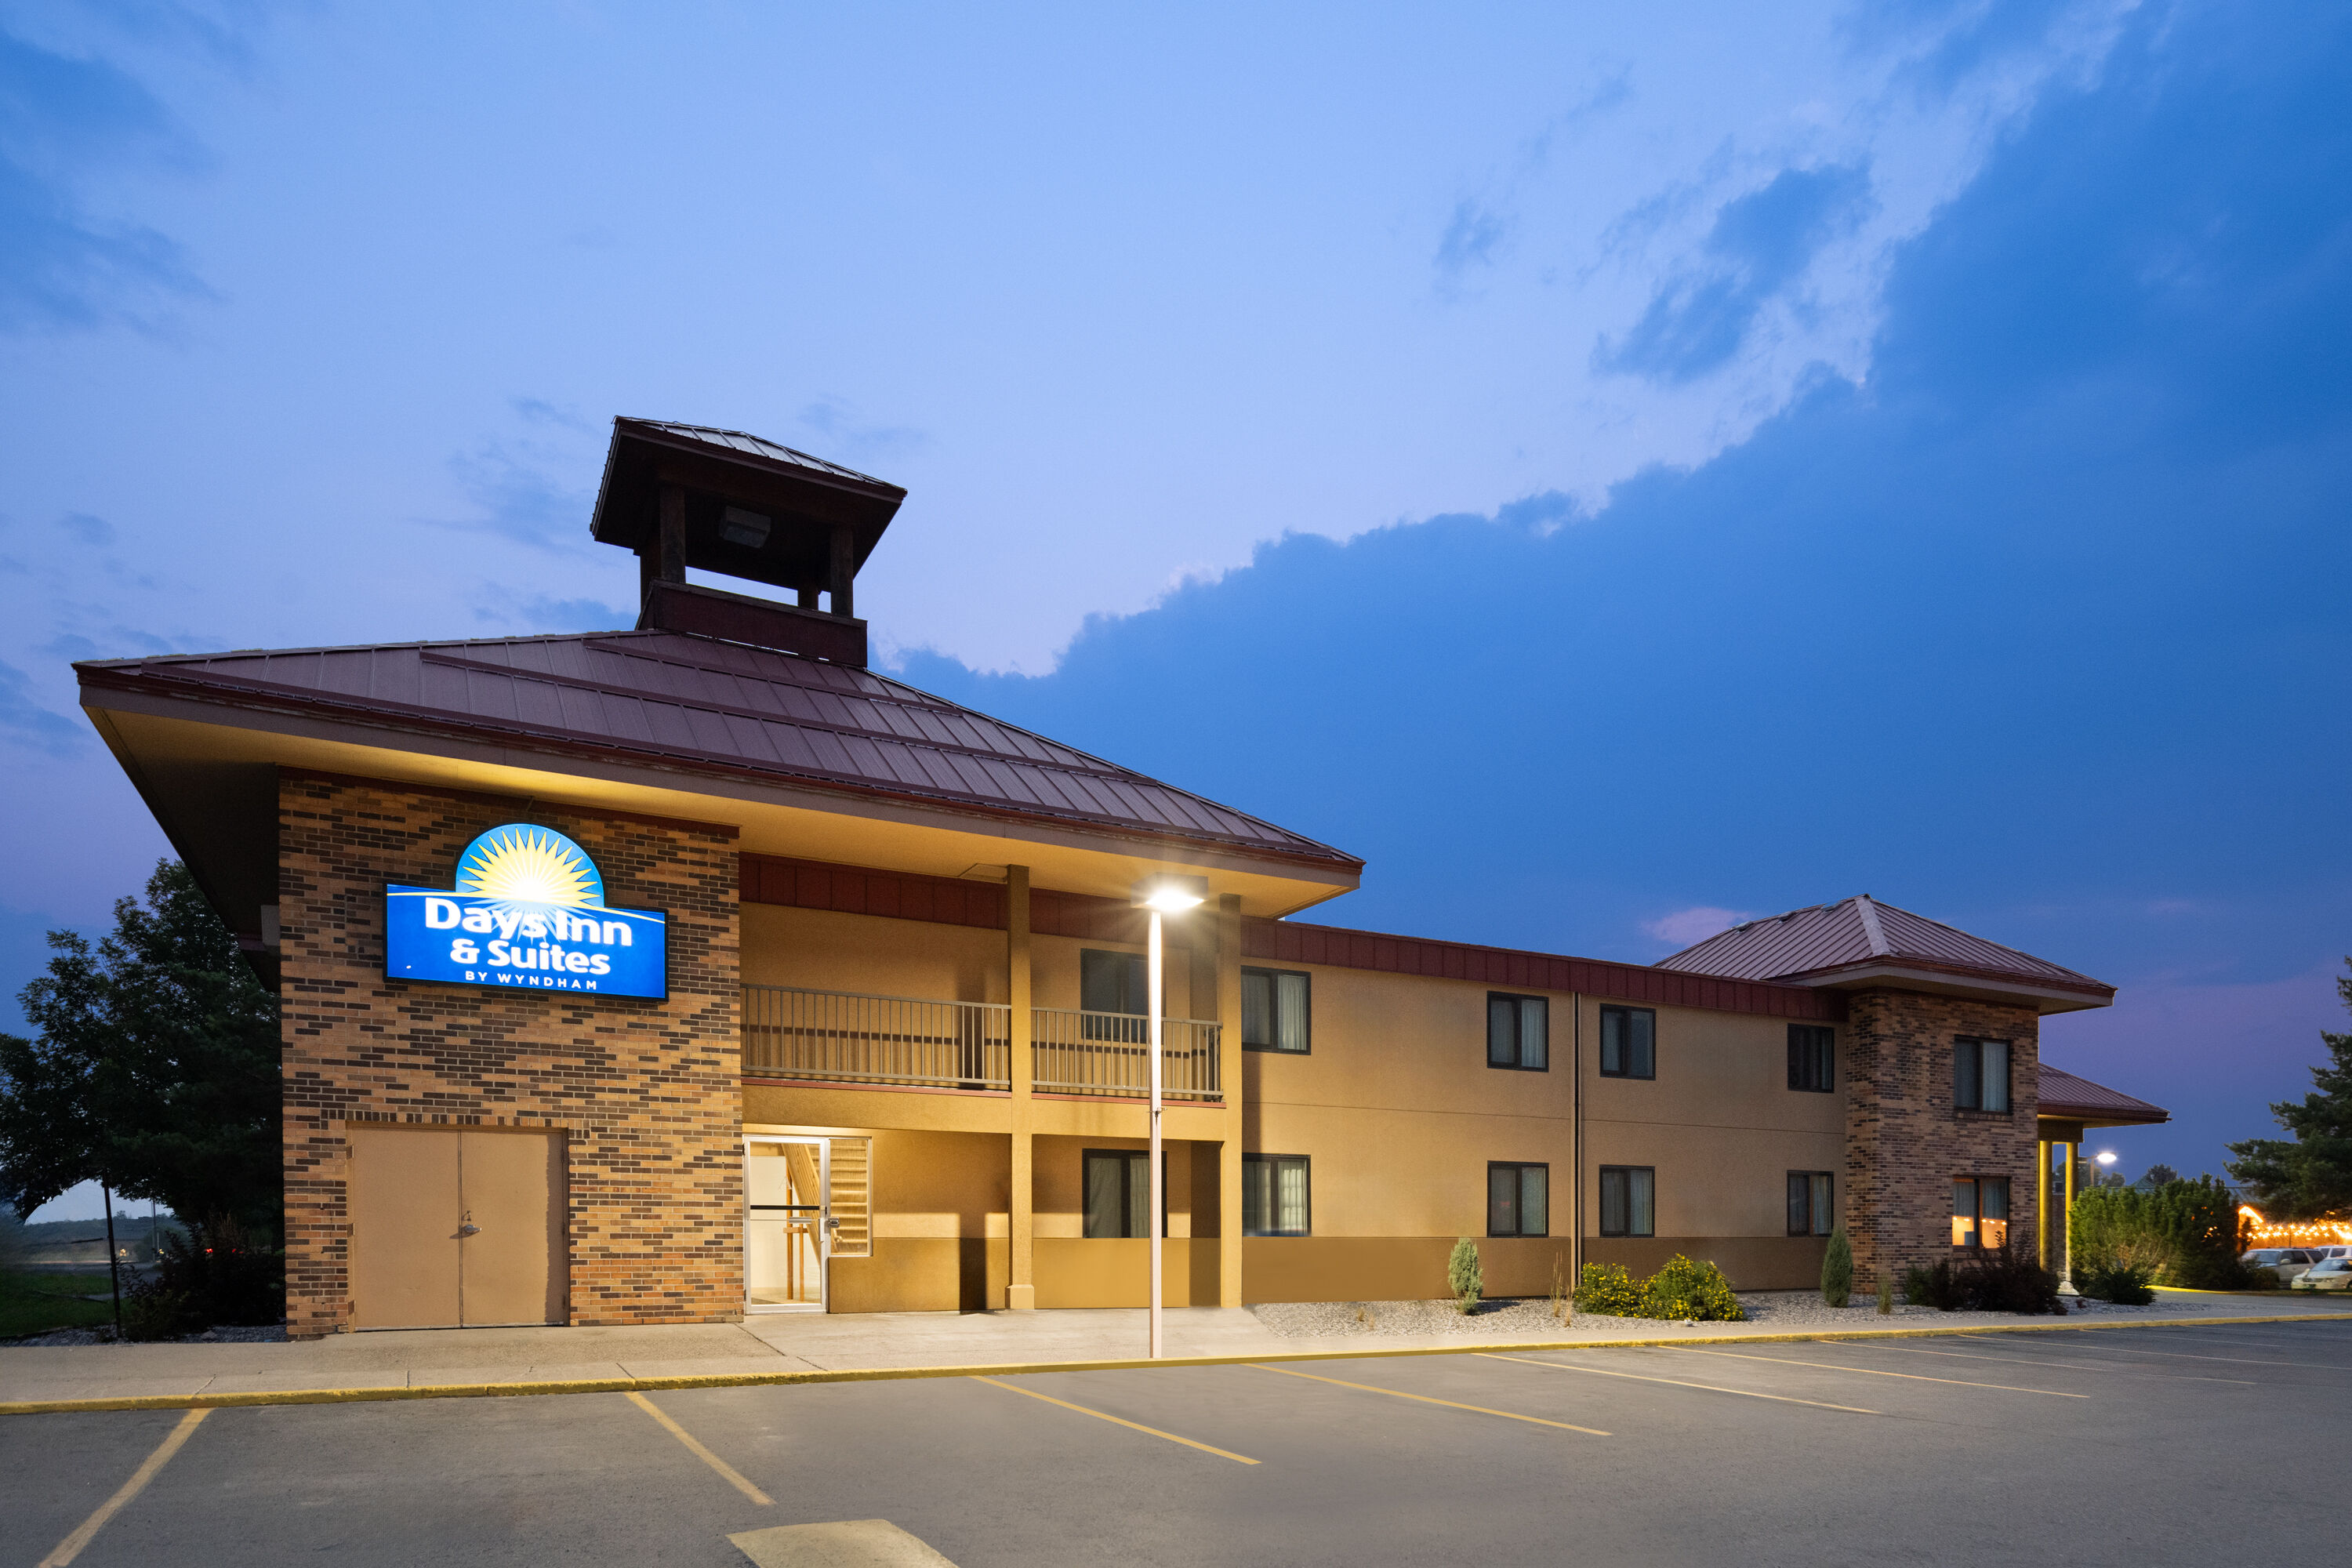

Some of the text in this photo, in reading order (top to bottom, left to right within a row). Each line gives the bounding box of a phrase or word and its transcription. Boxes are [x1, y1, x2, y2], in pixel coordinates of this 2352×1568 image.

[425, 897, 633, 947] Days Inn
[450, 938, 611, 975] & Suites
[465, 971, 597, 990] BY WYNDHAM
